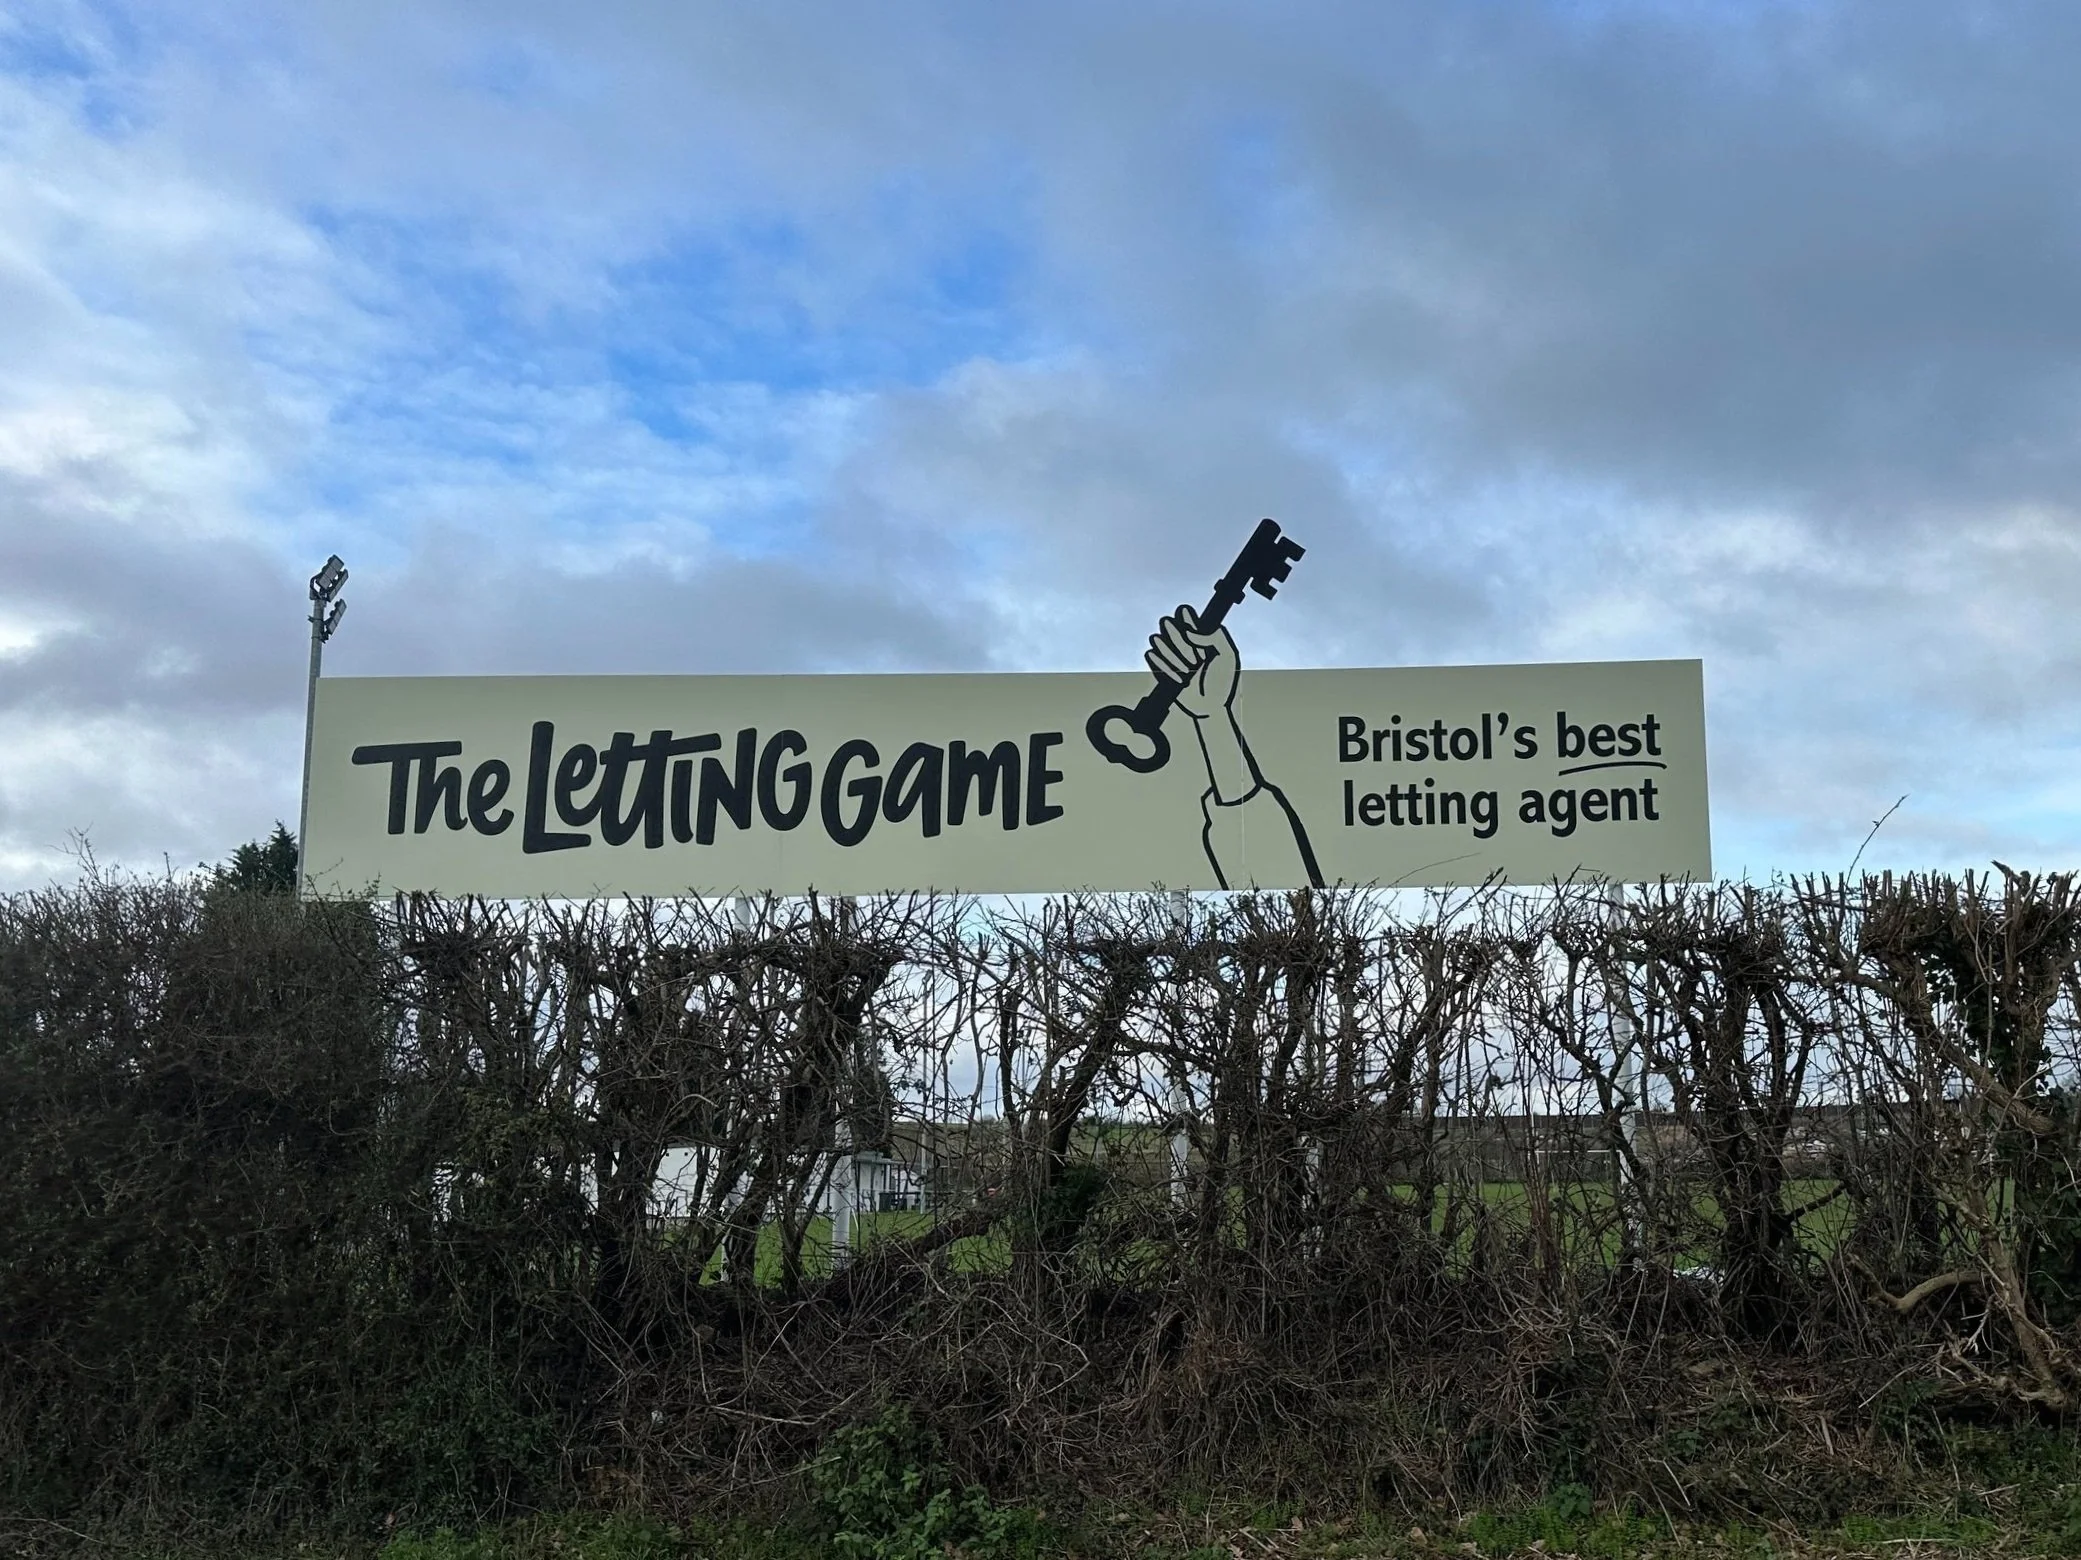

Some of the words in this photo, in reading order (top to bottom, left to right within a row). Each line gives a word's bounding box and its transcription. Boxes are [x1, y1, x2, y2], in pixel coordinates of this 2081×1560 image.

[1338, 711, 1539, 763] Bristol's
[1557, 711, 1663, 759] best
[352, 741, 514, 835] The
[1344, 779, 1499, 840] letting
[1519, 778, 1661, 839] agent
